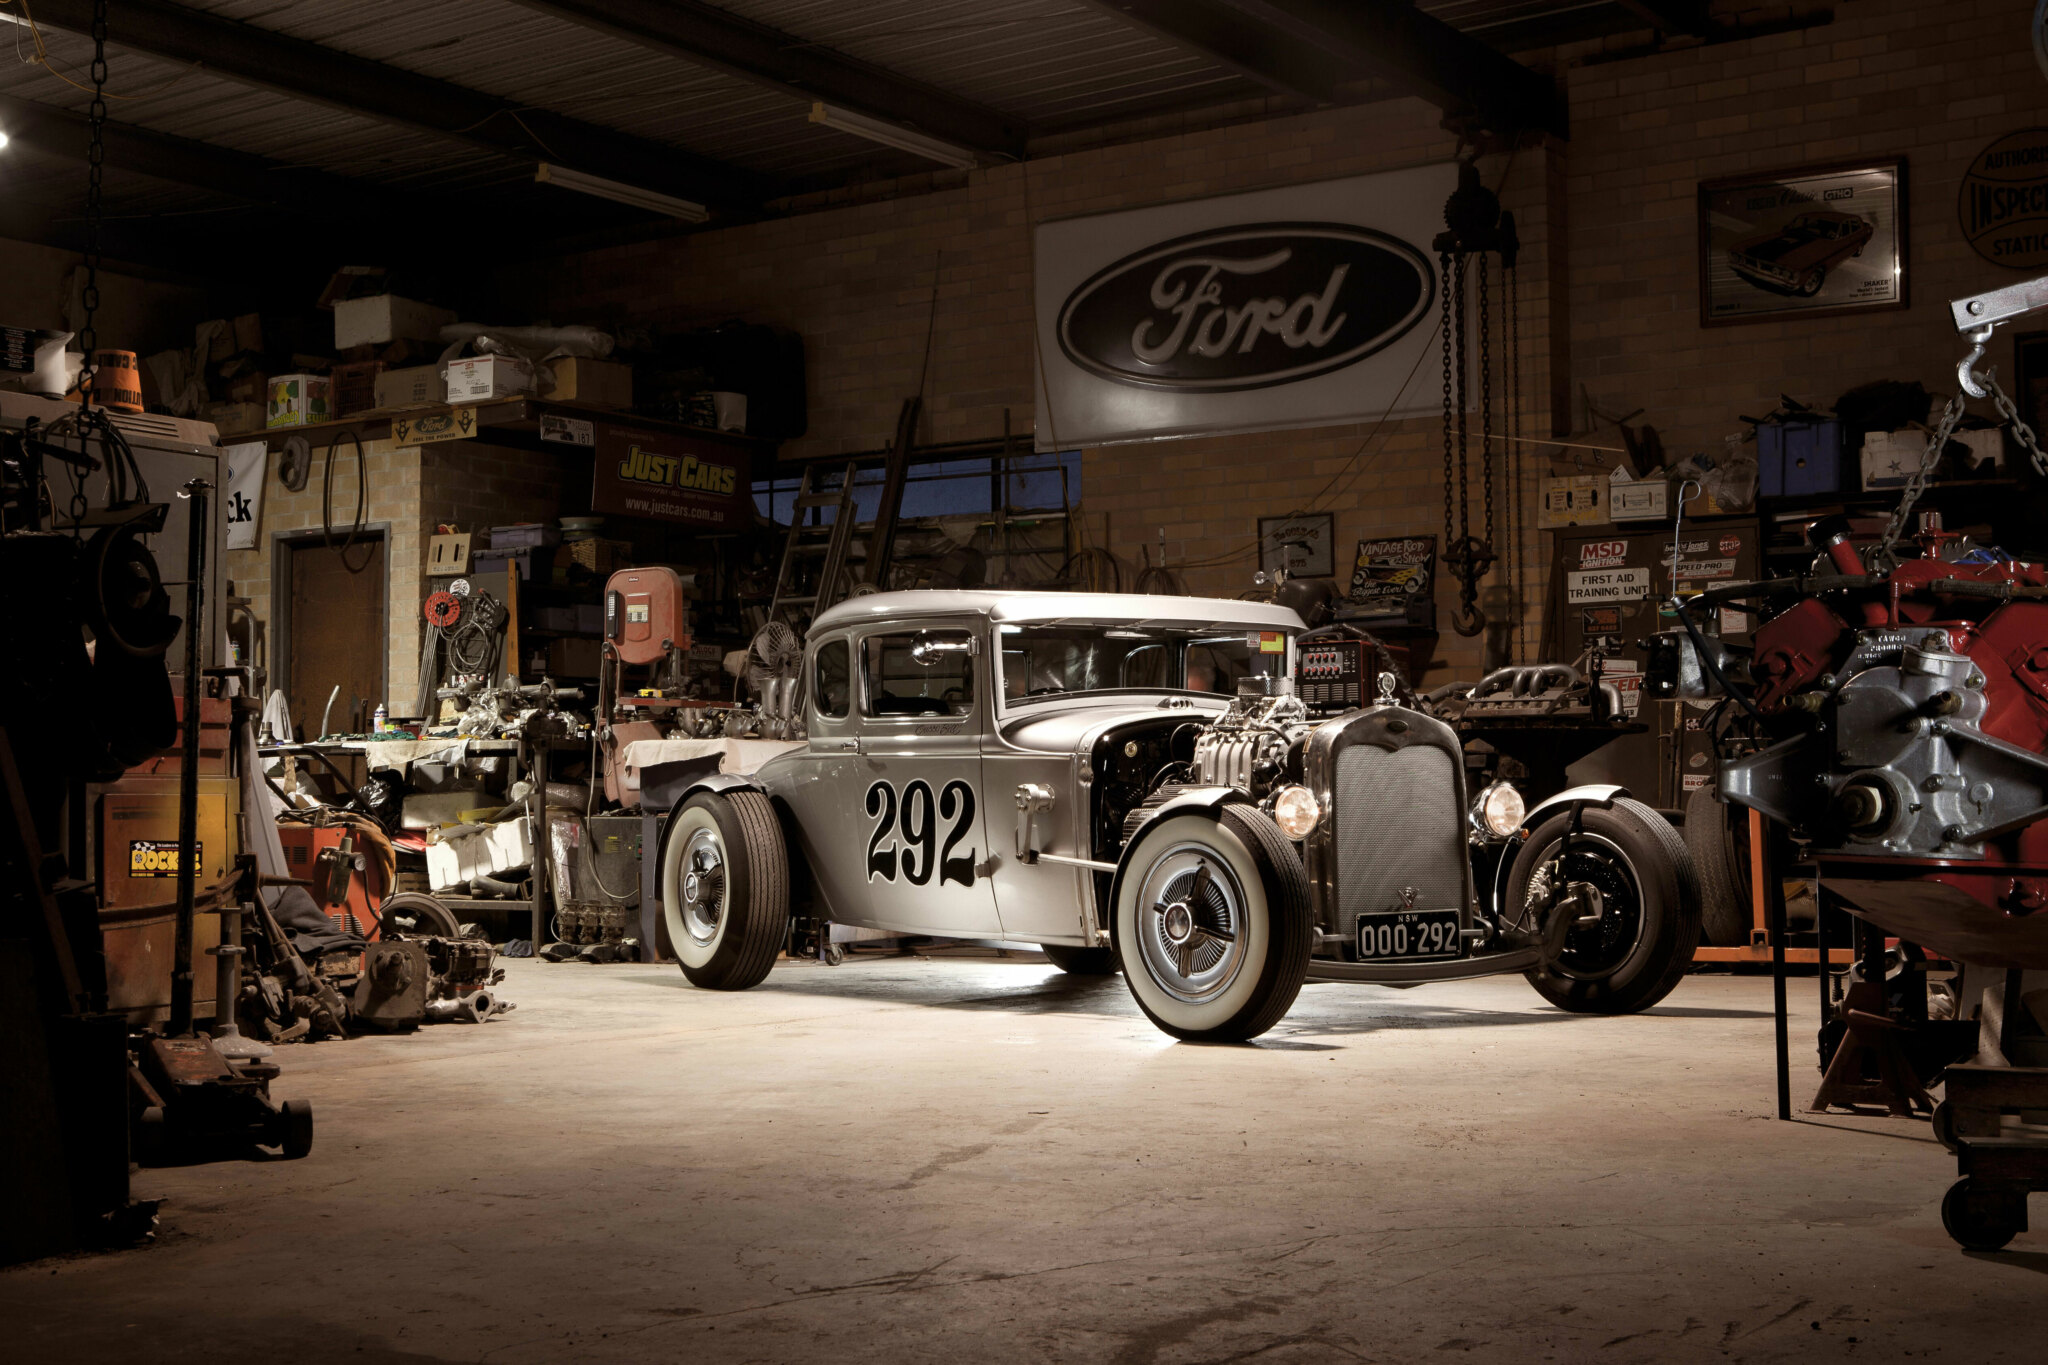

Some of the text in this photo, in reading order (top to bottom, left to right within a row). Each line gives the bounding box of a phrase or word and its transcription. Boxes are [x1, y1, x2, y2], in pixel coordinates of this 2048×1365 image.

[1824, 188, 1853, 200] GTHO
[1131, 247, 1350, 366] Ford
[421, 416, 448, 432] Ford
[619, 446, 736, 496] JUST CARS
[625, 498, 724, 522] www.justcars.com.au
[1360, 542, 1403, 556] VINTAGE
[1583, 542, 1625, 560] MSD
[1719, 541, 1740, 551] STOP
[1404, 552, 1431, 564] SHOW
[1583, 556, 1622, 568] IGNITION
[1582, 573, 1634, 585] FIRST AID
[1352, 585, 1403, 597] Biggest Ever!
[1569, 585, 1648, 598] TRAINING UNIT
[865, 778, 976, 887] 292
[1398, 914, 1419, 923] NSW
